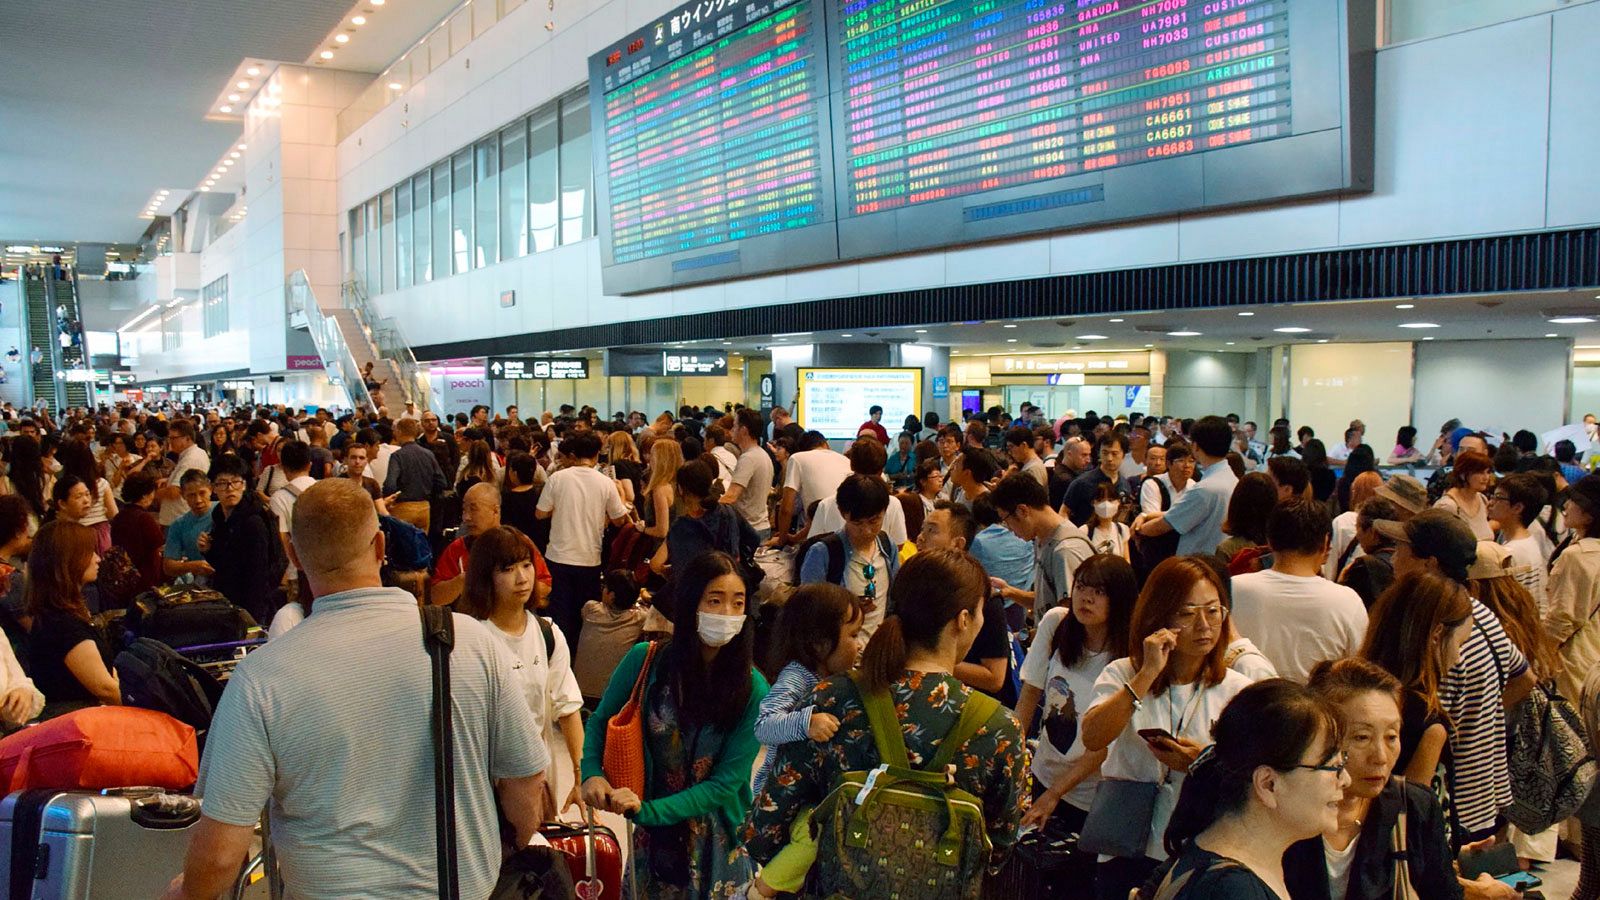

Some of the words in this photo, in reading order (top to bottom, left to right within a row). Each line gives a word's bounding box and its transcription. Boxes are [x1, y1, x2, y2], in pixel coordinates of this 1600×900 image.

[670, 0, 738, 36] 南ウイン
[974, 1, 994, 15] THAI
[903, 32, 946, 52] VANCOUVER
[904, 61, 938, 79] JAKARTA
[975, 43, 992, 55] ANA
[1078, 1, 1119, 21] GARUDA
[904, 45, 948, 65] VANCOUVER
[975, 28, 996, 42] THAI
[904, 74, 939, 91] CHICAGO
[975, 51, 1009, 68] UNITED
[1079, 23, 1099, 37] ANA
[905, 85, 944, 103] HONOLULU
[977, 70, 992, 82] ANA
[1079, 32, 1120, 51] UNITED
[1143, 12, 1187, 33] UA7981
[1204, 0, 1255, 15] CUSTO
[1205, 23, 1264, 48] CUSTOMS
[905, 101, 935, 116] DENVER
[977, 79, 1011, 95] UNITED
[1080, 53, 1100, 66] ANA
[1143, 27, 1188, 48] NH7033
[1081, 81, 1108, 95] THAI
[1206, 41, 1265, 64] CUSTOMS
[908, 141, 932, 153] BUSAN
[1207, 56, 1274, 81] ARRIVING
[1145, 92, 1191, 110] NH7951
[909, 162, 948, 178] SHANGHAI
[981, 151, 997, 161] ANA
[1032, 136, 1064, 150] NH920
[1146, 108, 1191, 126] CA6661
[910, 176, 939, 191] DALIAN
[981, 165, 998, 175] ANA
[1033, 150, 1064, 165] NH904
[1146, 124, 1193, 142] CA6687
[982, 178, 999, 189] ANA
[1147, 140, 1194, 157] CA6683
[786, 192, 812, 206] ARRIVED
[451, 379, 484, 390] peach
